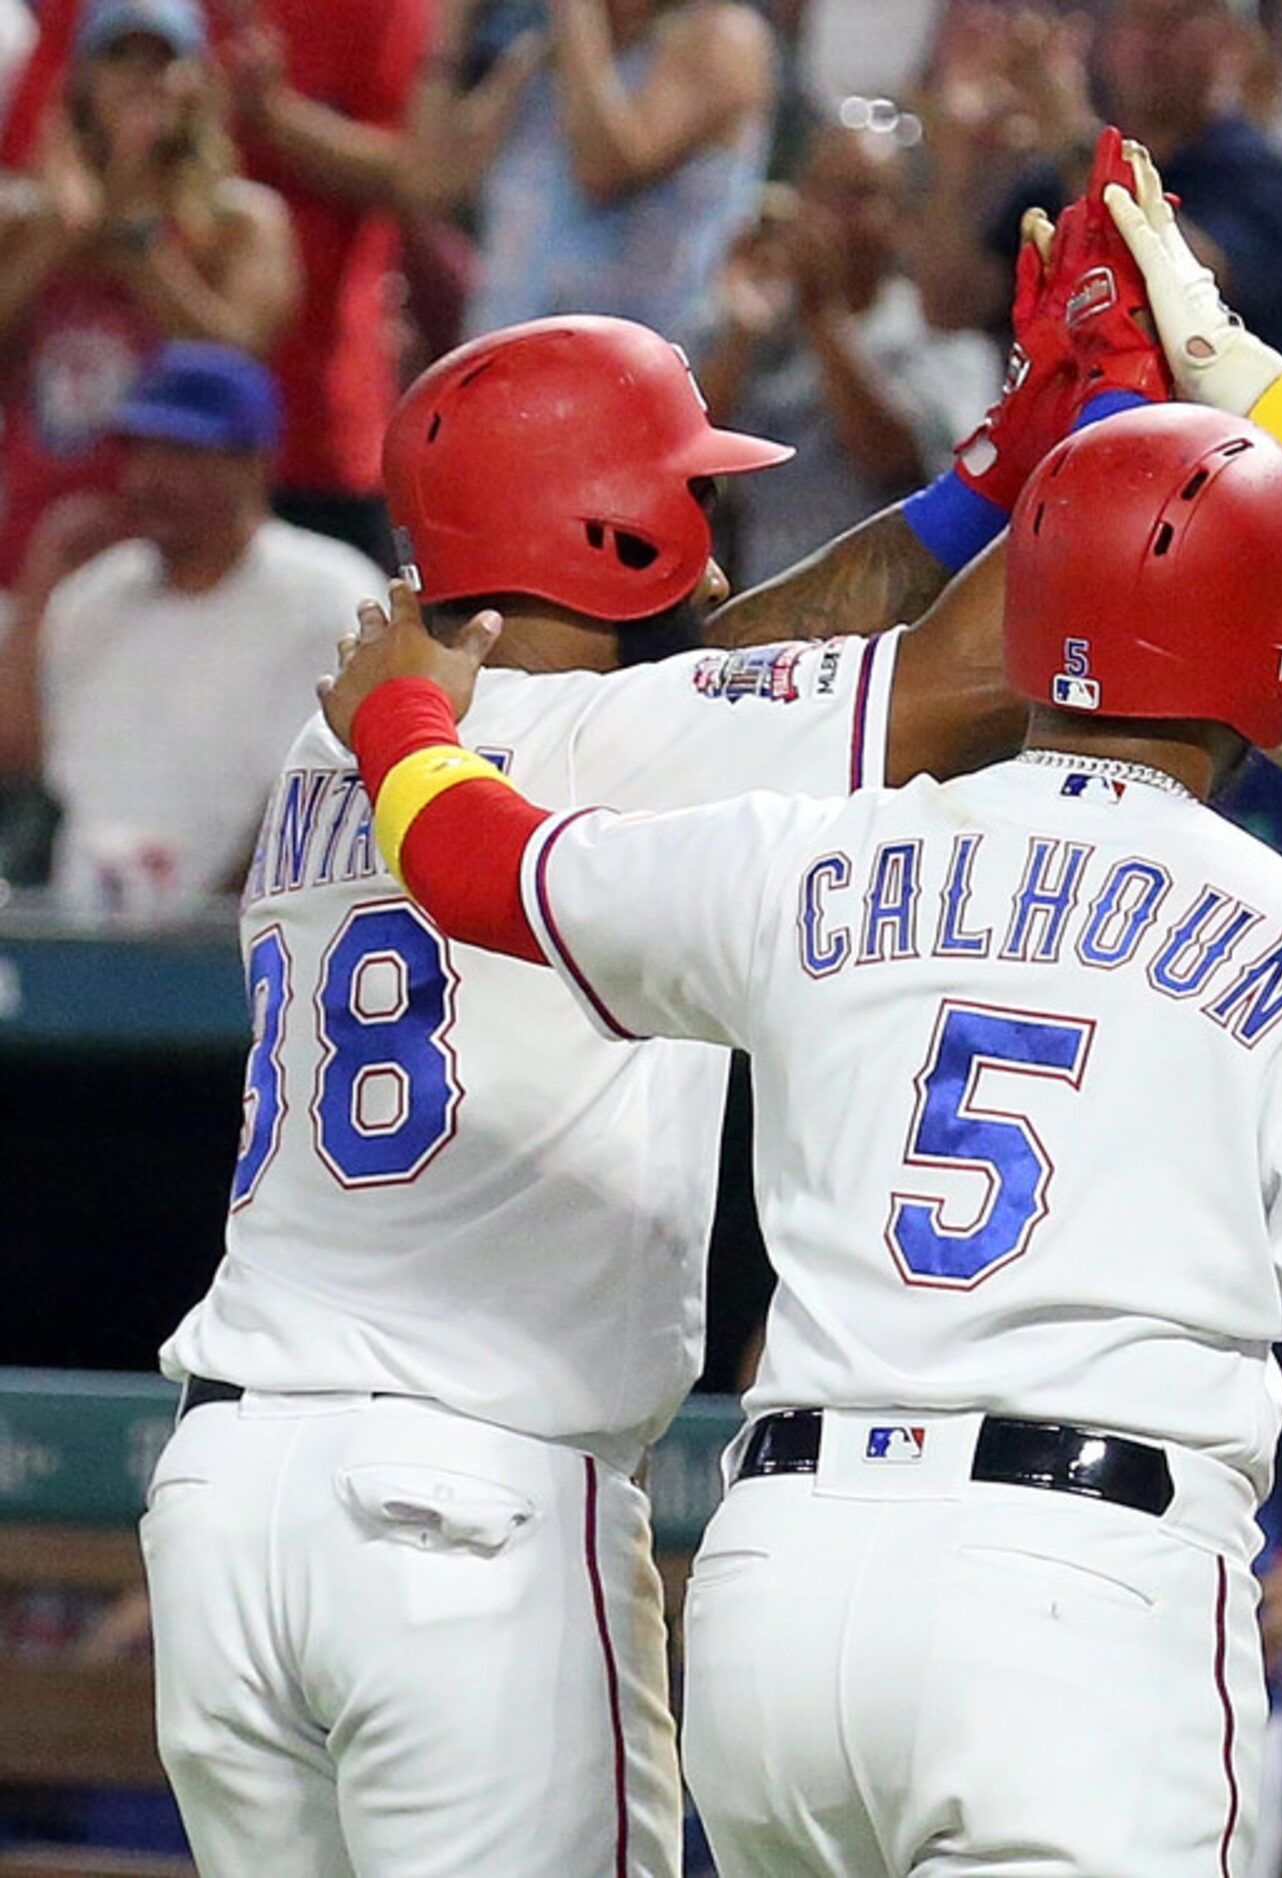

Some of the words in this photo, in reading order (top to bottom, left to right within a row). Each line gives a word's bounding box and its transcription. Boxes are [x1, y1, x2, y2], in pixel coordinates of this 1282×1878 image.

[1063, 636, 1090, 678] 5
[229, 895, 467, 1215] 38
[884, 998, 1097, 1291] 5
